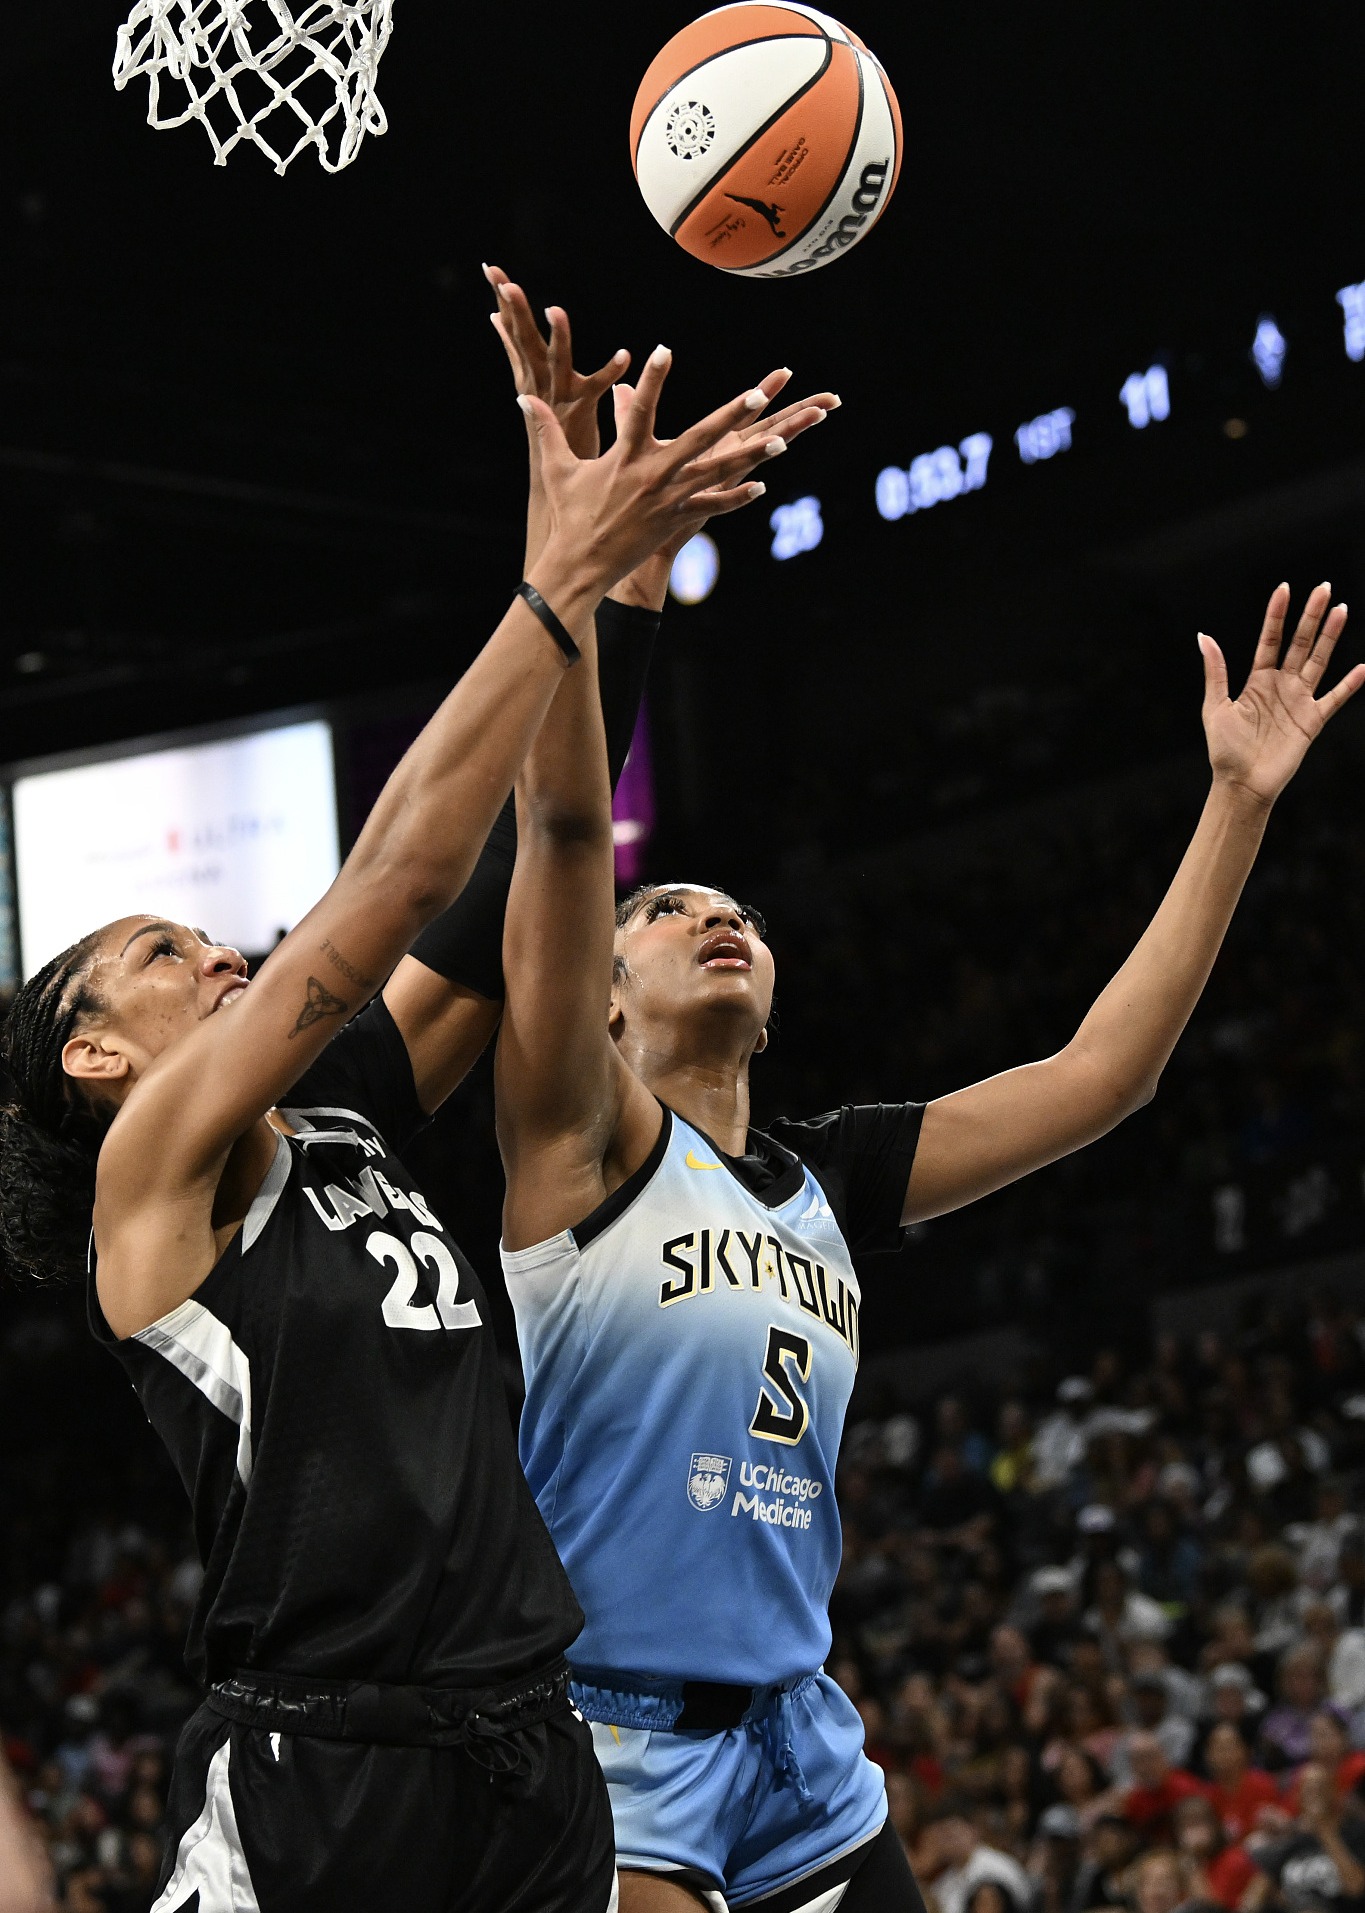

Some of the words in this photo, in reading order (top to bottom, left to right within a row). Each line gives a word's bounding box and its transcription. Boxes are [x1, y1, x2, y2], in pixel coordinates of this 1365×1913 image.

[365, 1230, 483, 1331] 22
[748, 1323, 814, 1447] 5
[731, 1491, 812, 1530] Medicine
[740, 1461, 823, 1502] UChicago
